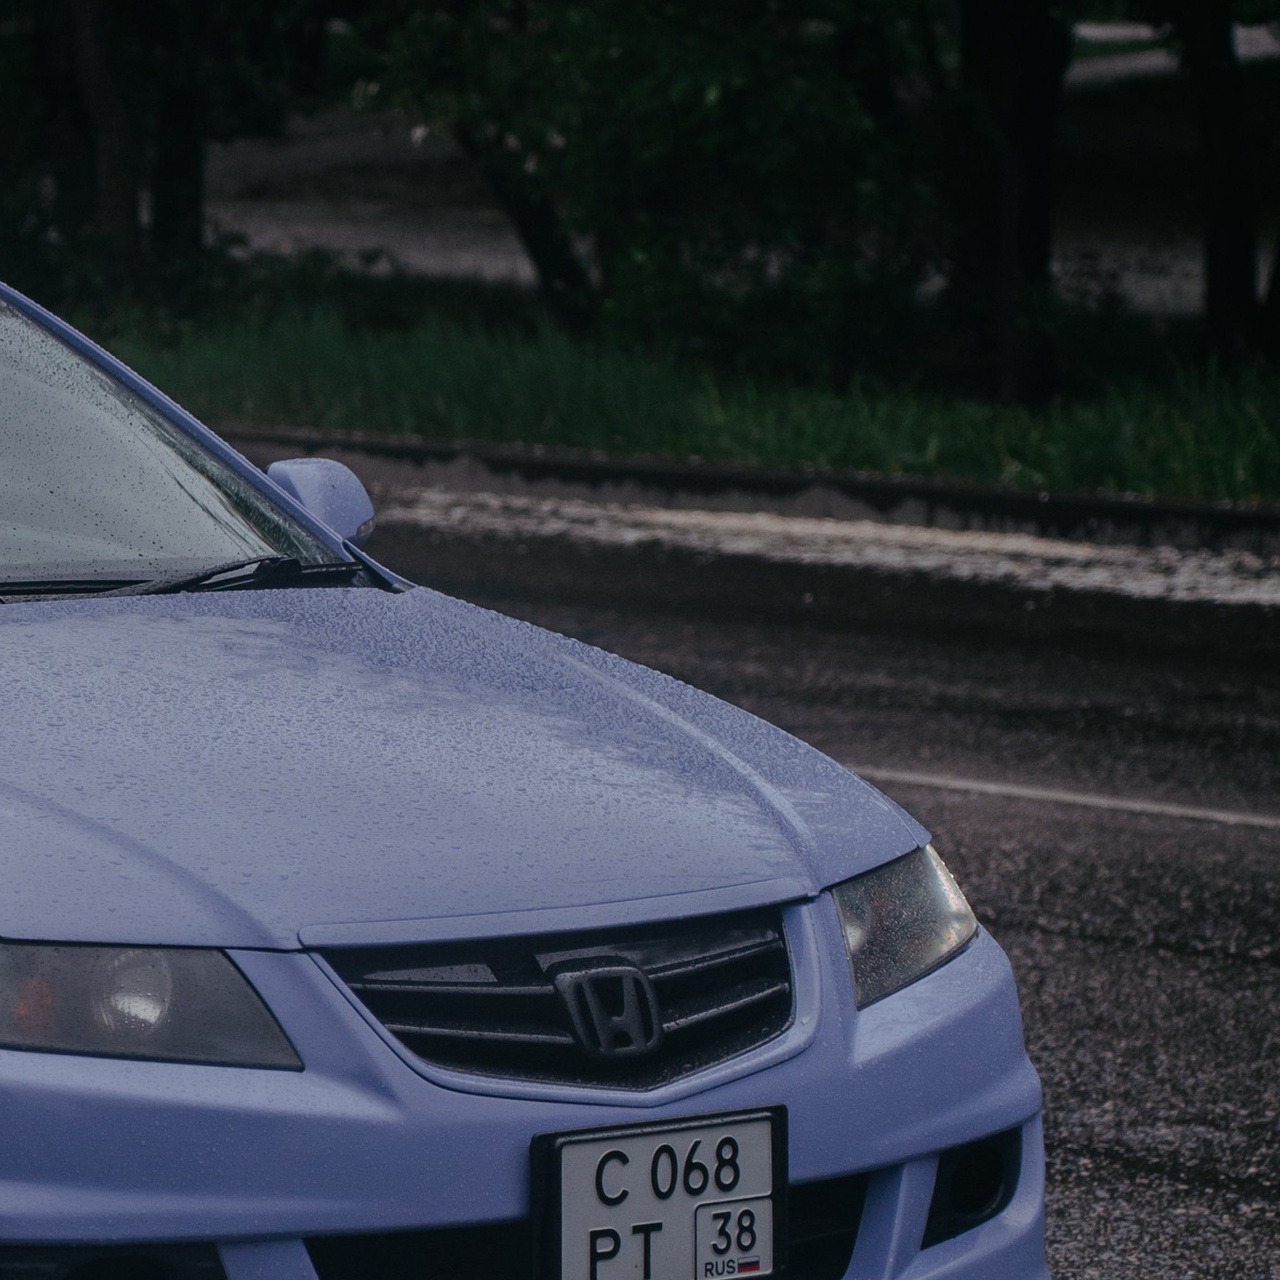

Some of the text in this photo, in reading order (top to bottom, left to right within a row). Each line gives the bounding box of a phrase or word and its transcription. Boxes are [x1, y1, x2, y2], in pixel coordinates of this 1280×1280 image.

[595, 1137, 740, 1206] C 068
[712, 1209, 757, 1255] 38
[704, 1259, 736, 1277] RUS
